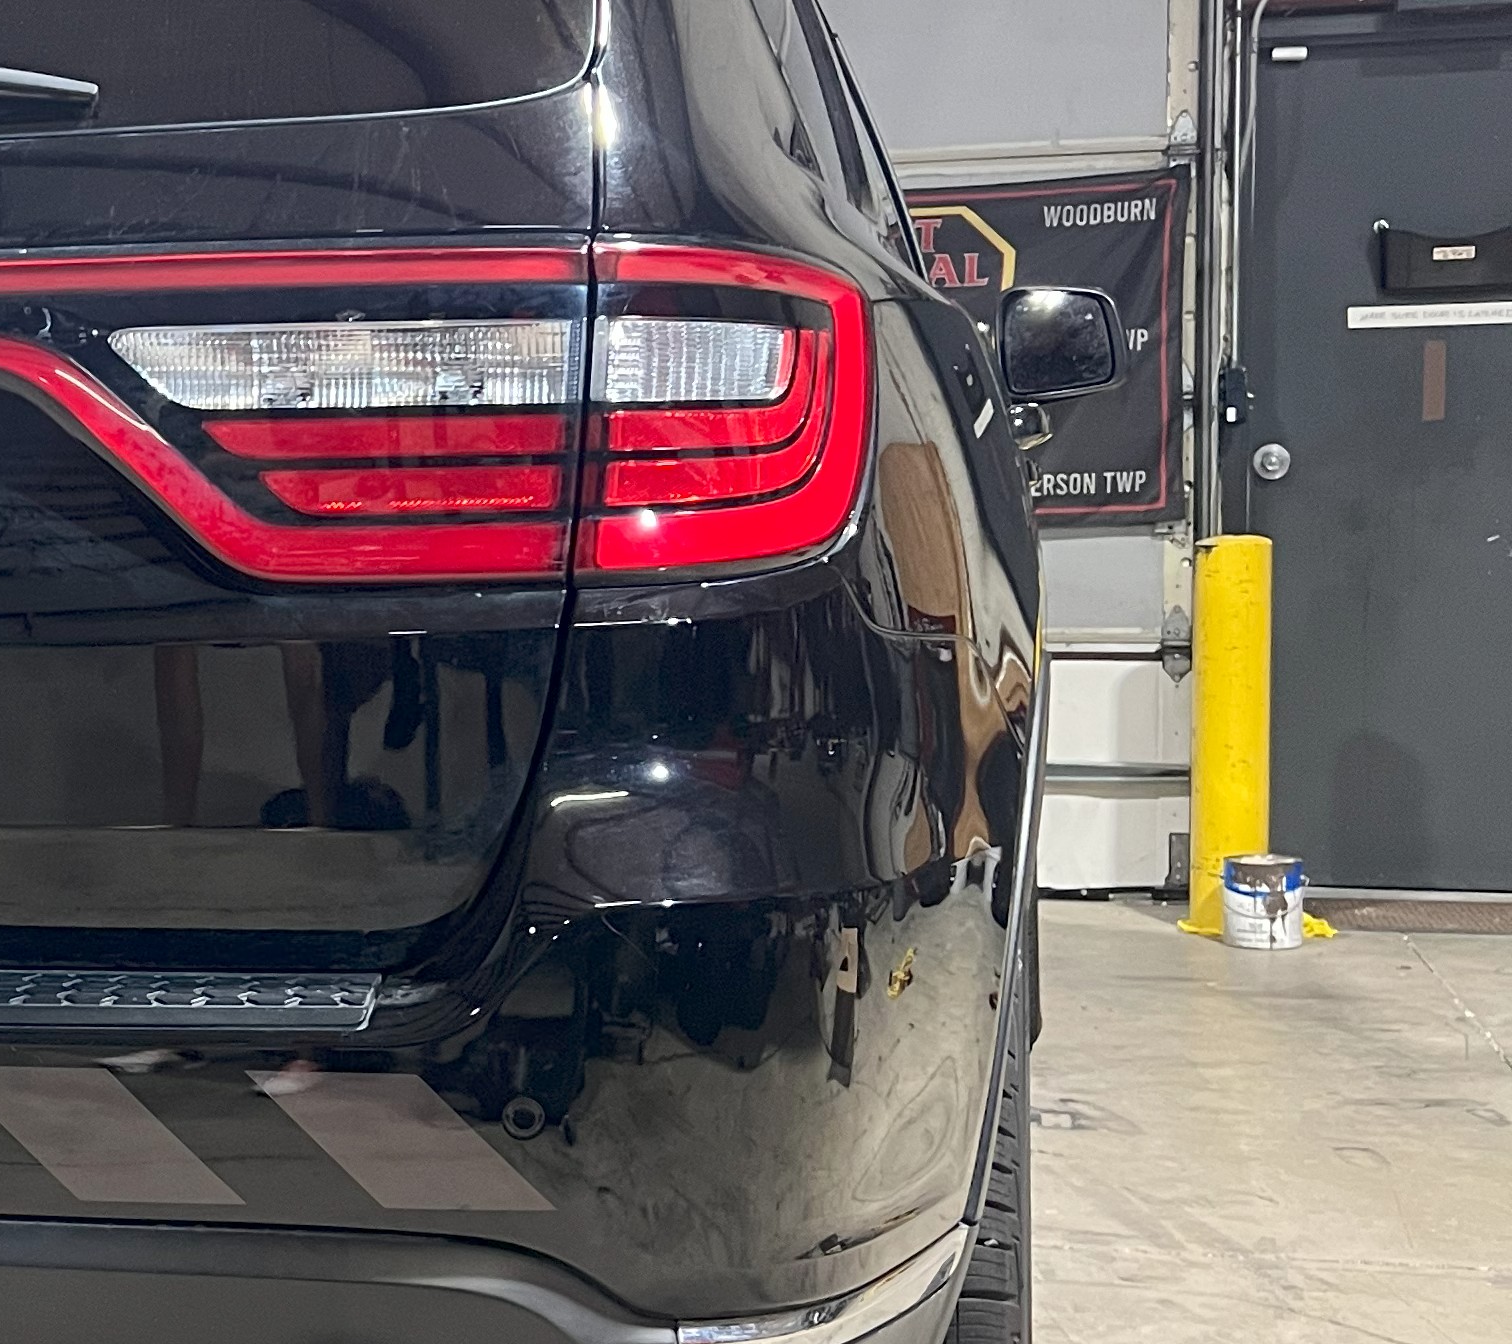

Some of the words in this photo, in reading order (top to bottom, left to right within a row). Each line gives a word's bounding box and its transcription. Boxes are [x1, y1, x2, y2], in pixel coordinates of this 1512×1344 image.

[1043, 198, 1157, 228] WOODBURN
[929, 252, 990, 288] AL
[1103, 470, 1147, 494] TWP
